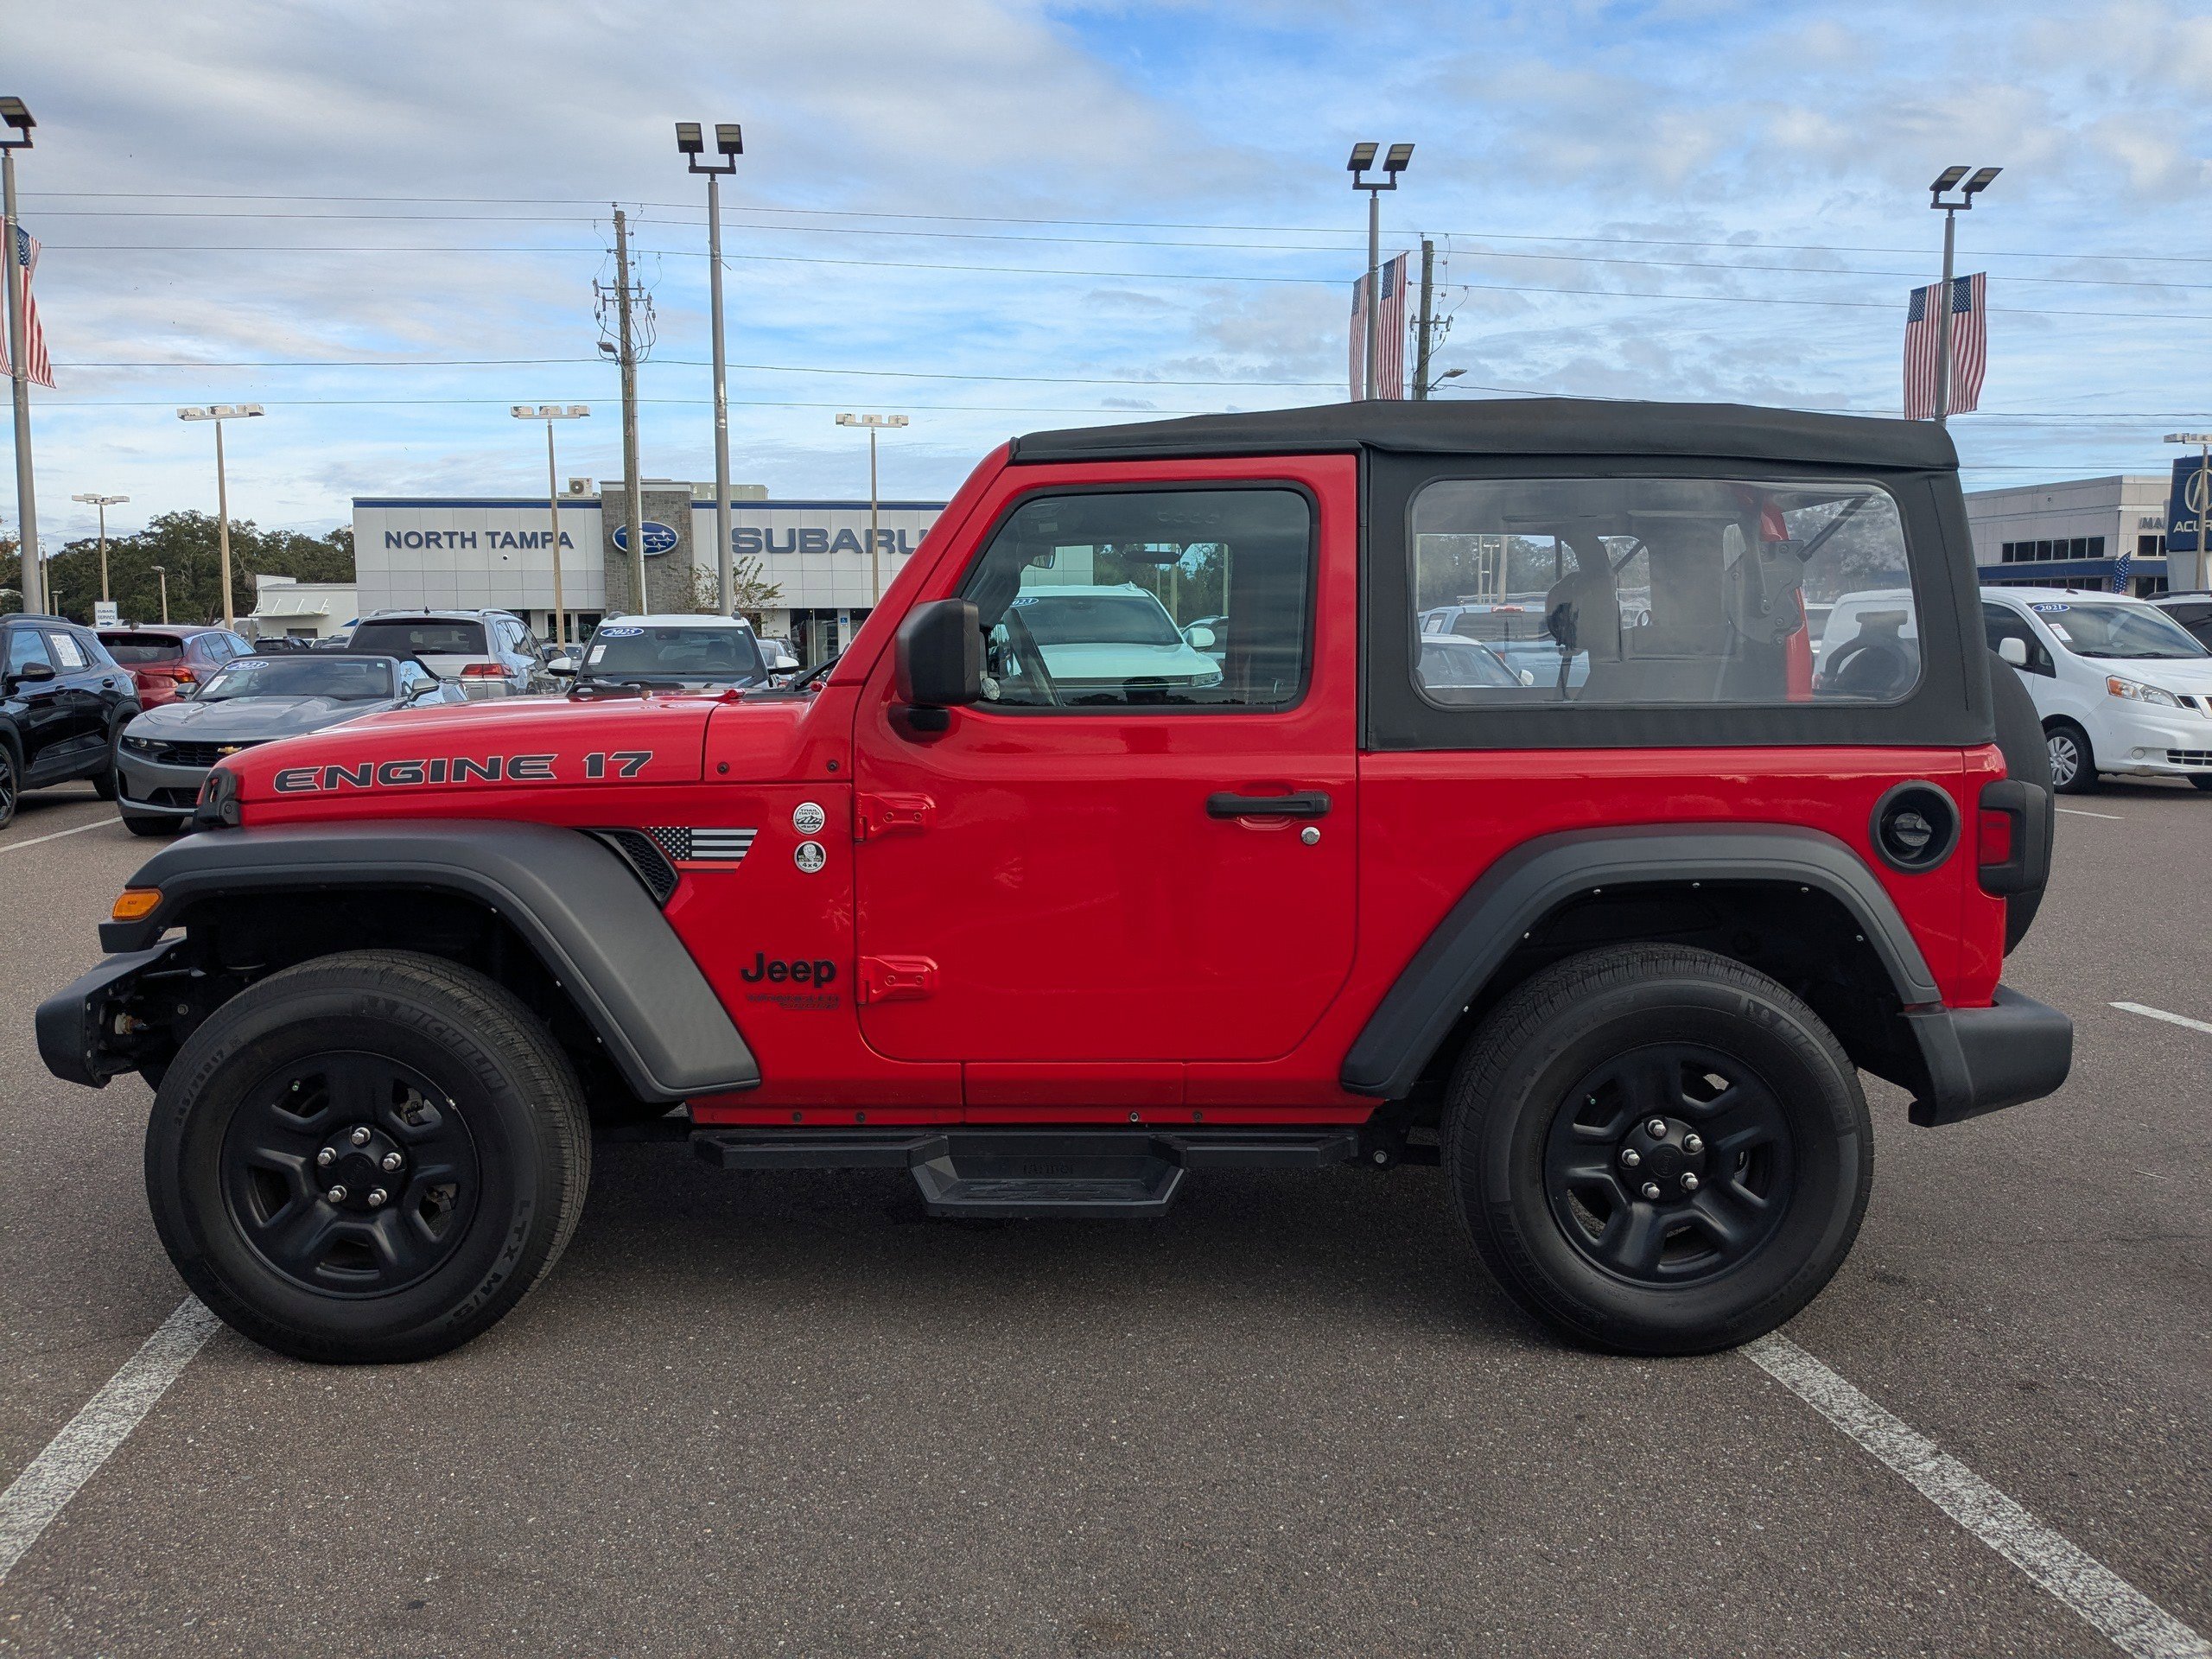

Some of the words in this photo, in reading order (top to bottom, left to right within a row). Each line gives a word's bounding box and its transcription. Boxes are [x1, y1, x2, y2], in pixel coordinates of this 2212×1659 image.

[385, 531, 477, 550] NORTH
[485, 531, 575, 550] TAMPA
[731, 527, 929, 554] SUBARU
[2173, 520, 2212, 533] ACUR
[273, 753, 558, 793] ENGINE
[582, 751, 653, 779] 17
[741, 952, 836, 988] Jeep
[394, 1002, 509, 1093] MICHELIN
